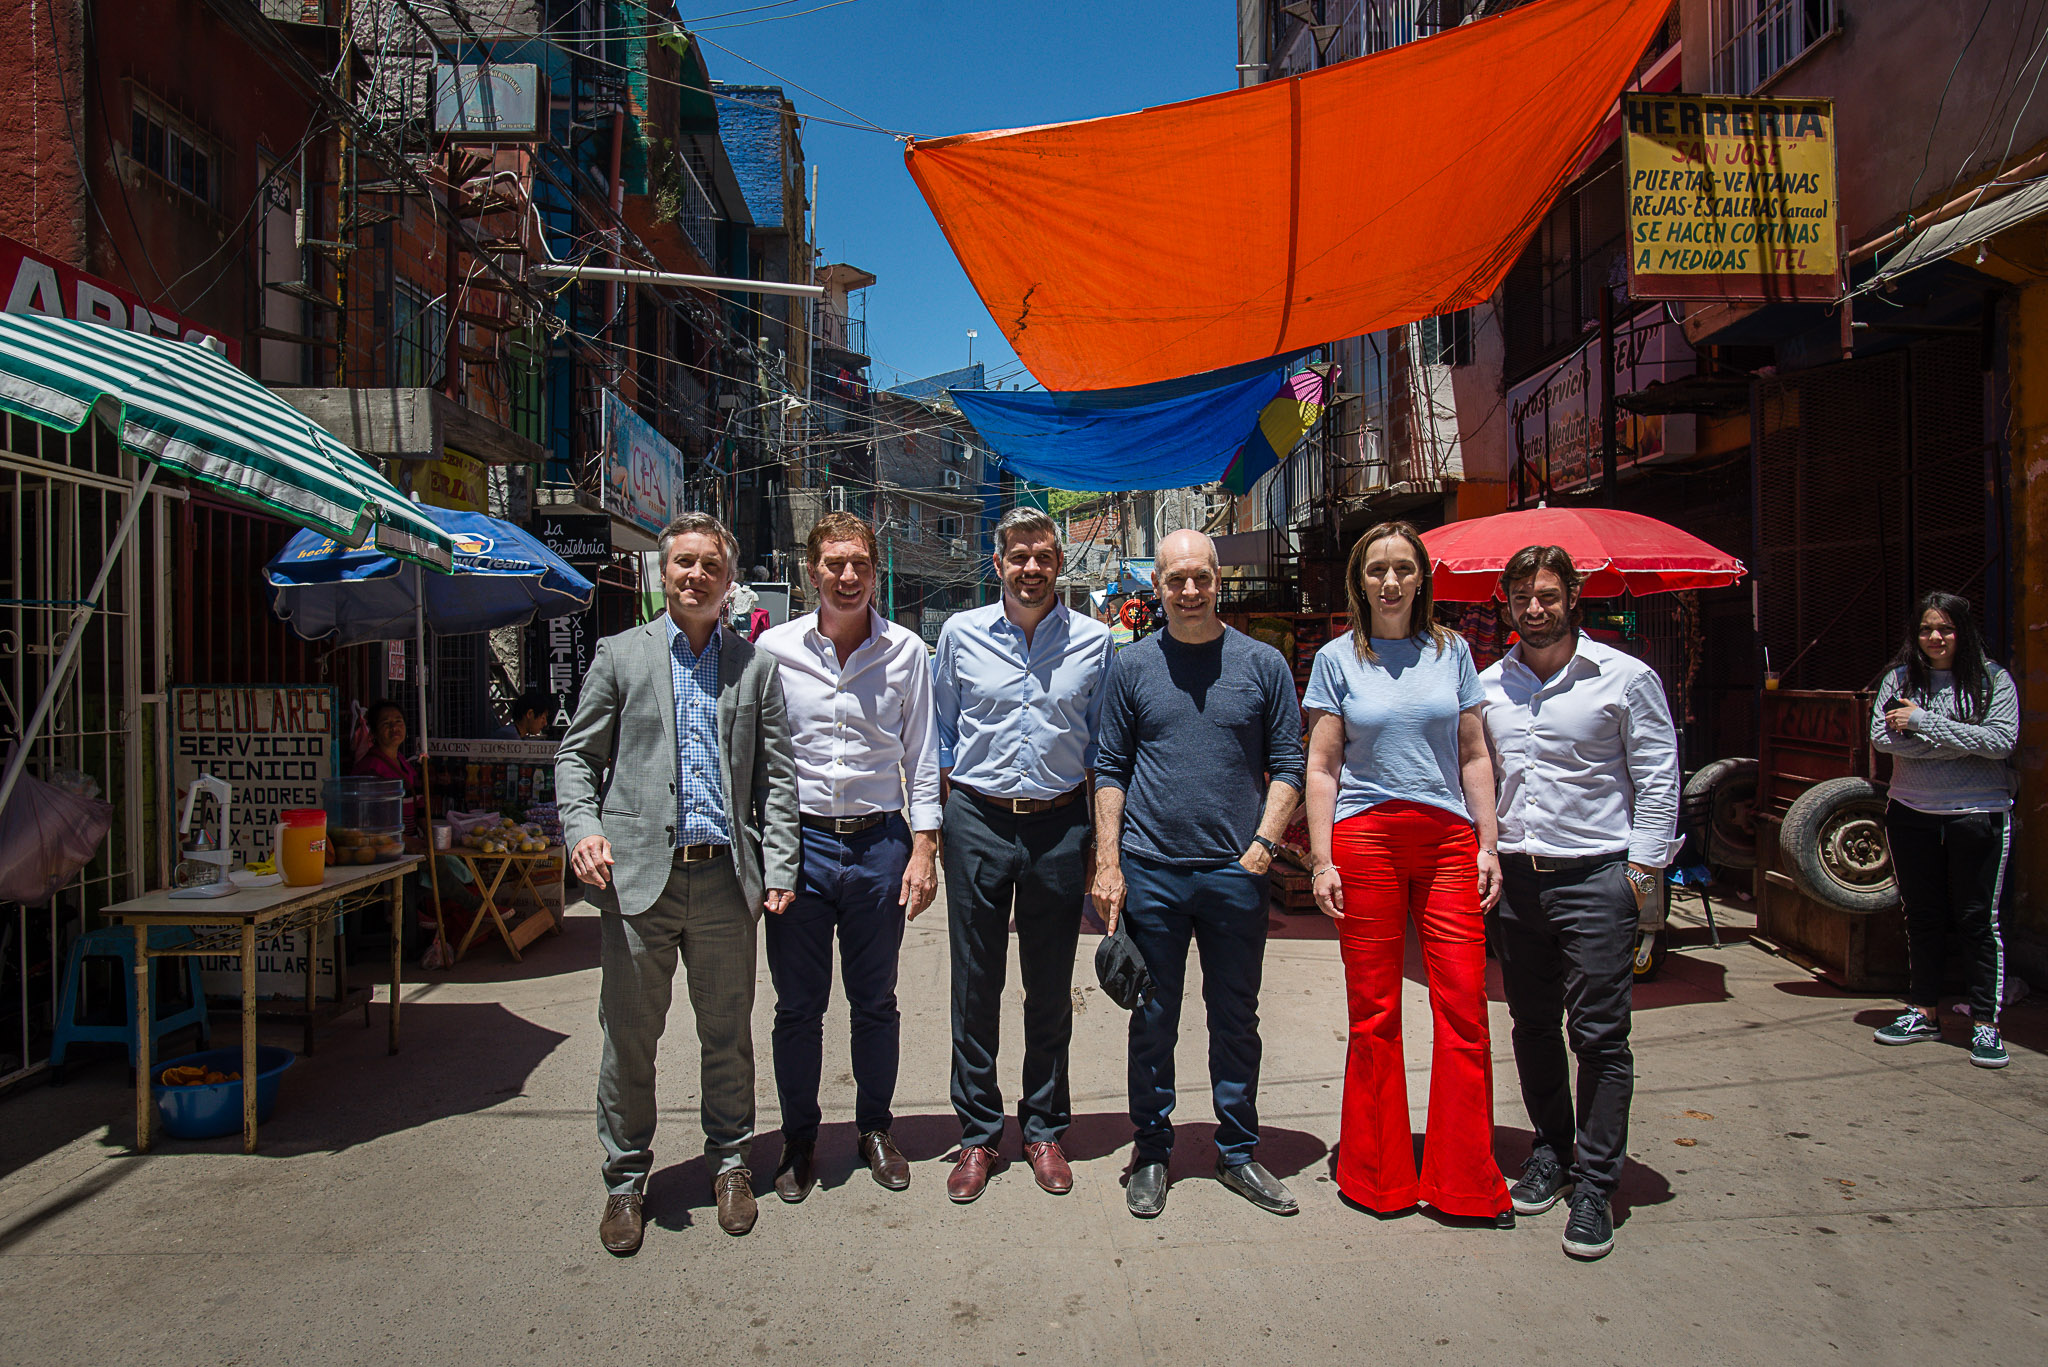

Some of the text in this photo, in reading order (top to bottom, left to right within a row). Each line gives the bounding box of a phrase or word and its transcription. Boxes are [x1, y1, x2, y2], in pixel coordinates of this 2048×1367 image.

[1628, 101, 1823, 138] HERRERIA
[1780, 199, 1828, 219] Caracol
[1634, 221, 1821, 244] SE HACEN CORTINAS
[1636, 249, 1808, 271] A MEDIDAS TEL
[543, 519, 564, 536] La
[177, 689, 331, 734] CELULARES
[180, 735, 323, 757] SERVICIO
[480, 743, 522, 754] KIOSKO
[191, 760, 317, 781] TECNICO
